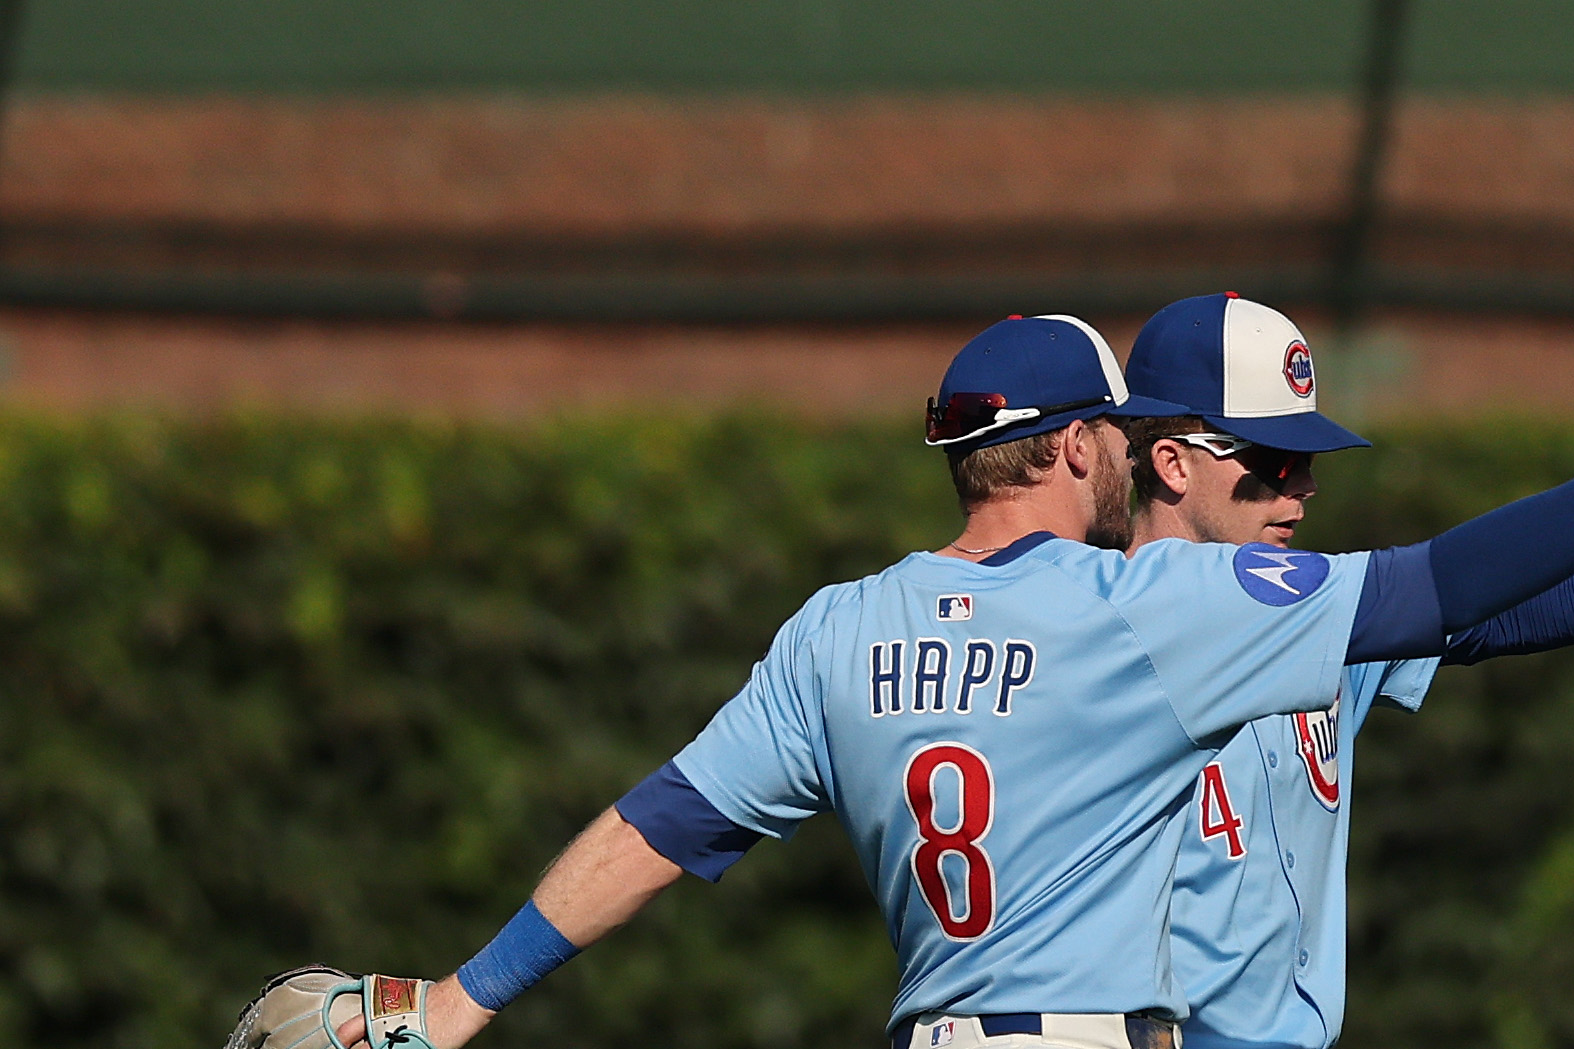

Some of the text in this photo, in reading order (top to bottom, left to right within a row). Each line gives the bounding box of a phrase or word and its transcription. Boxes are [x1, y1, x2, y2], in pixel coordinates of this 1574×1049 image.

[869, 637, 1036, 717] HAPP
[903, 741, 996, 942] 8
[1199, 761, 1247, 860] 4
